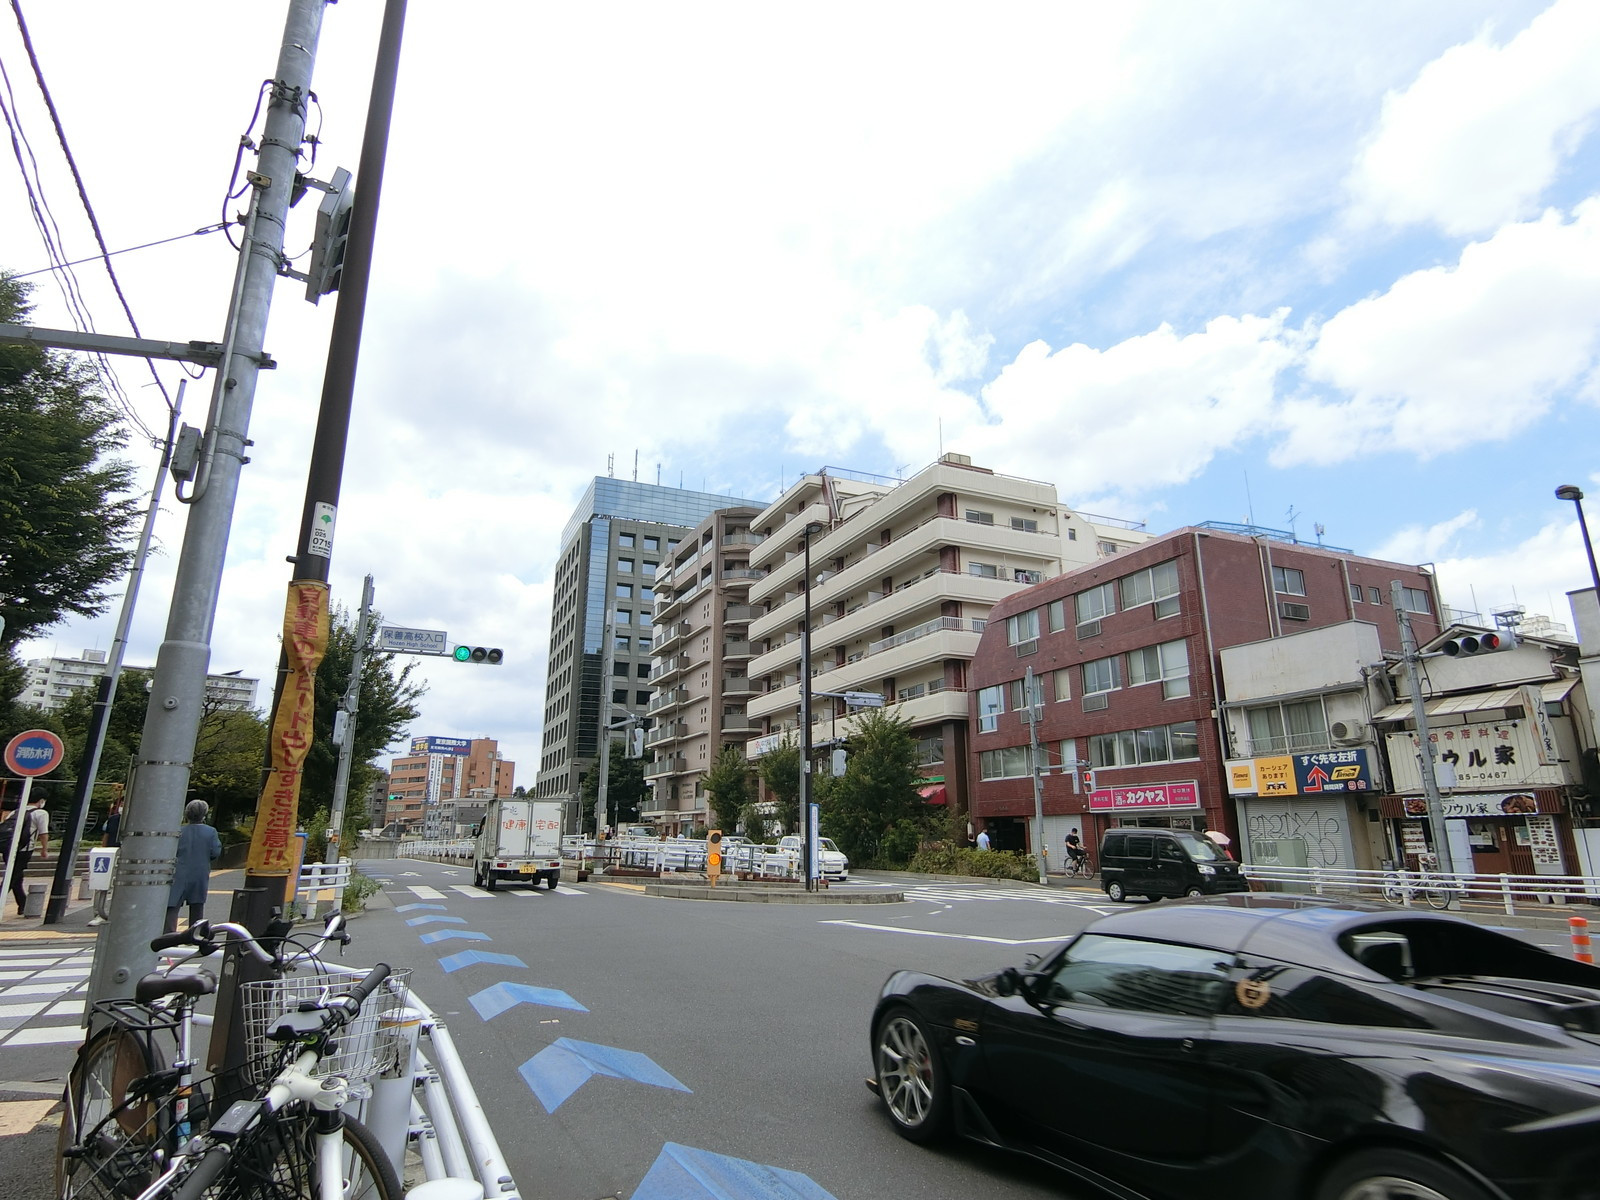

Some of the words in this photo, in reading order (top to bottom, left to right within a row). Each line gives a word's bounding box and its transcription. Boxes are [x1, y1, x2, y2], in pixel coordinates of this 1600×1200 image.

[312, 538, 331, 548] 0715
[383, 630, 444, 642] 保善高校入口
[15, 746, 53, 759] 消防水利
[1301, 751, 1357, 766] すぐ先を左折
[1416, 745, 1516, 767] ウル家
[1260, 764, 1288, 772] カーシェア
[1455, 772, 1507, 781] 85-0467
[1126, 789, 1165, 804] カクヤス
[1442, 803, 1489, 814] ソウル家
[503, 818, 527, 831] 健康
[536, 818, 559, 831] 宅配
